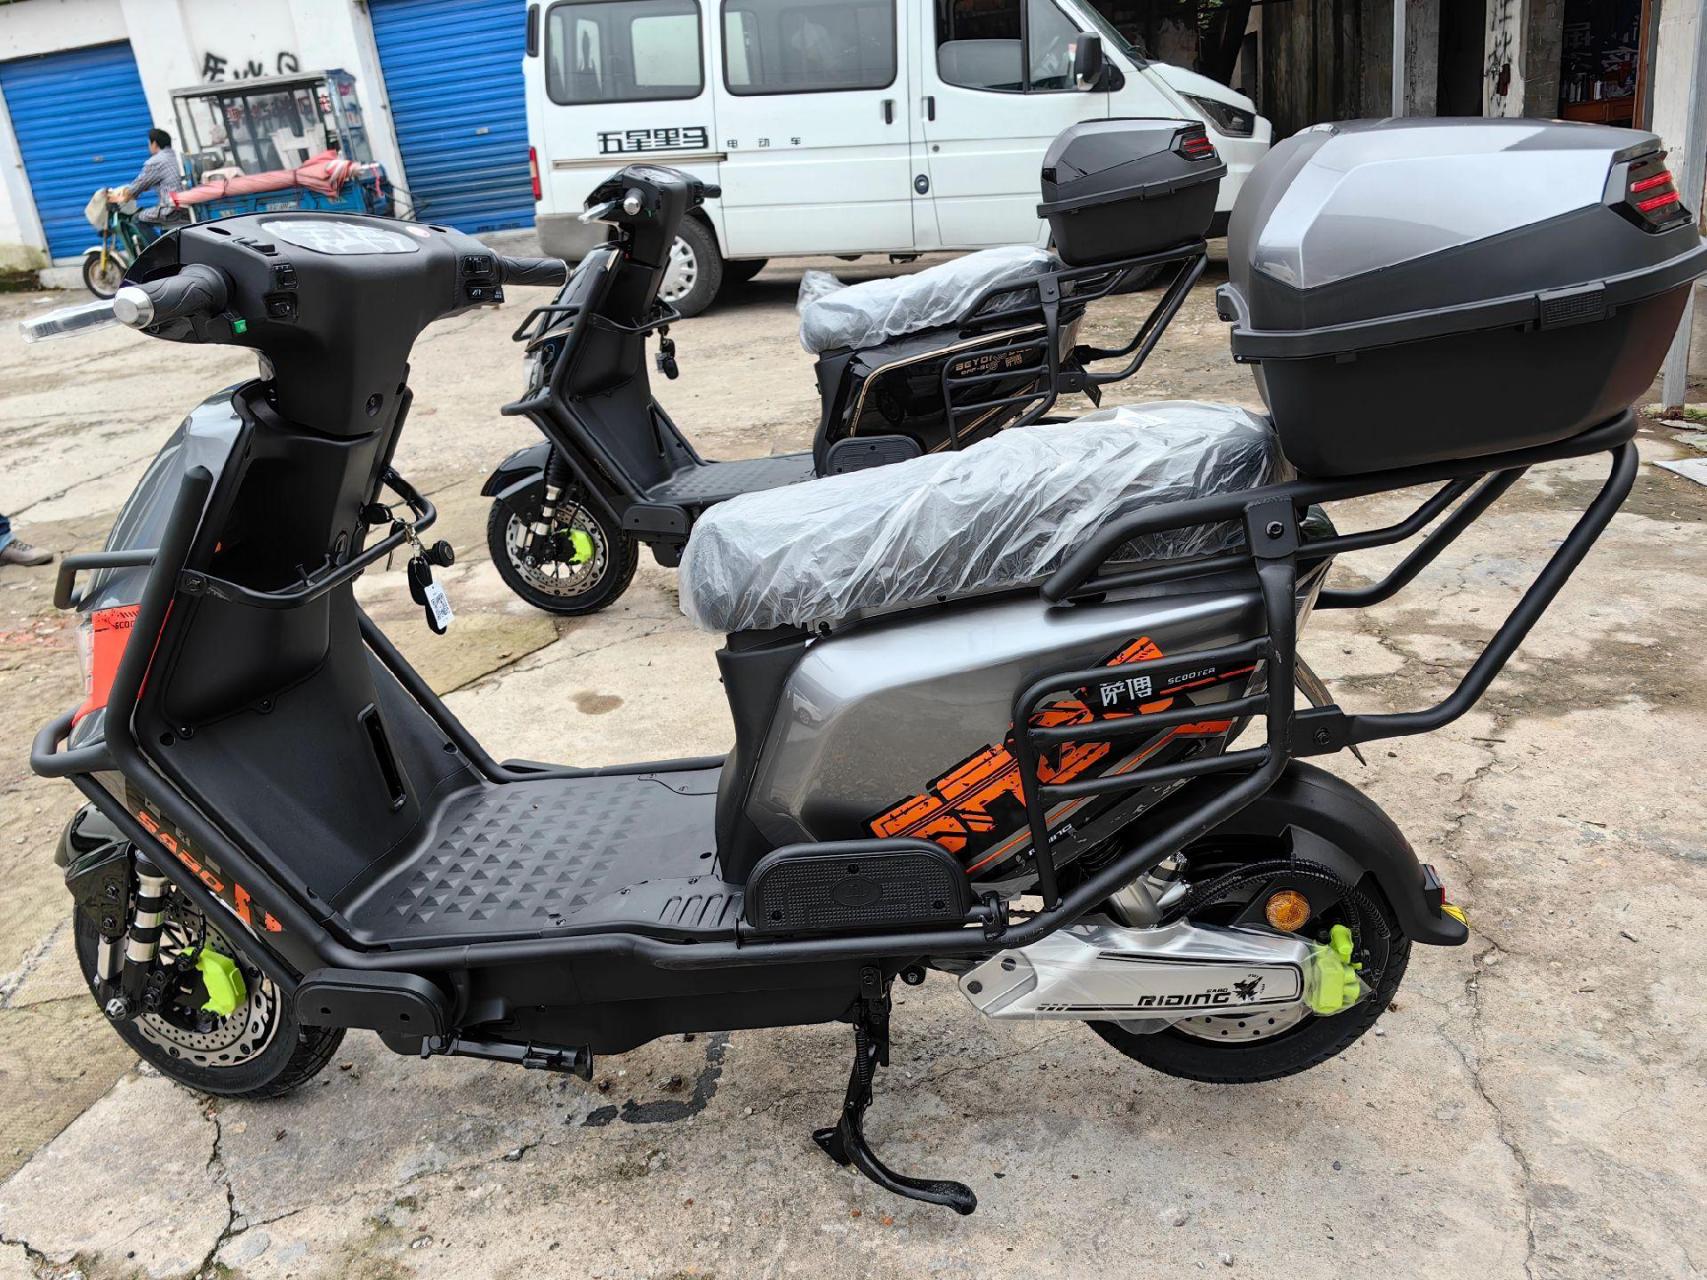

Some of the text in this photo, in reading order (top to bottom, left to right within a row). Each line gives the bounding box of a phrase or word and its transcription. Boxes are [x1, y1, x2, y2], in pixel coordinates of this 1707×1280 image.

[727, 137, 801, 148] 电动车
[1167, 667, 1216, 685] SCOOTER
[1137, 992, 1232, 1006] RIDING
